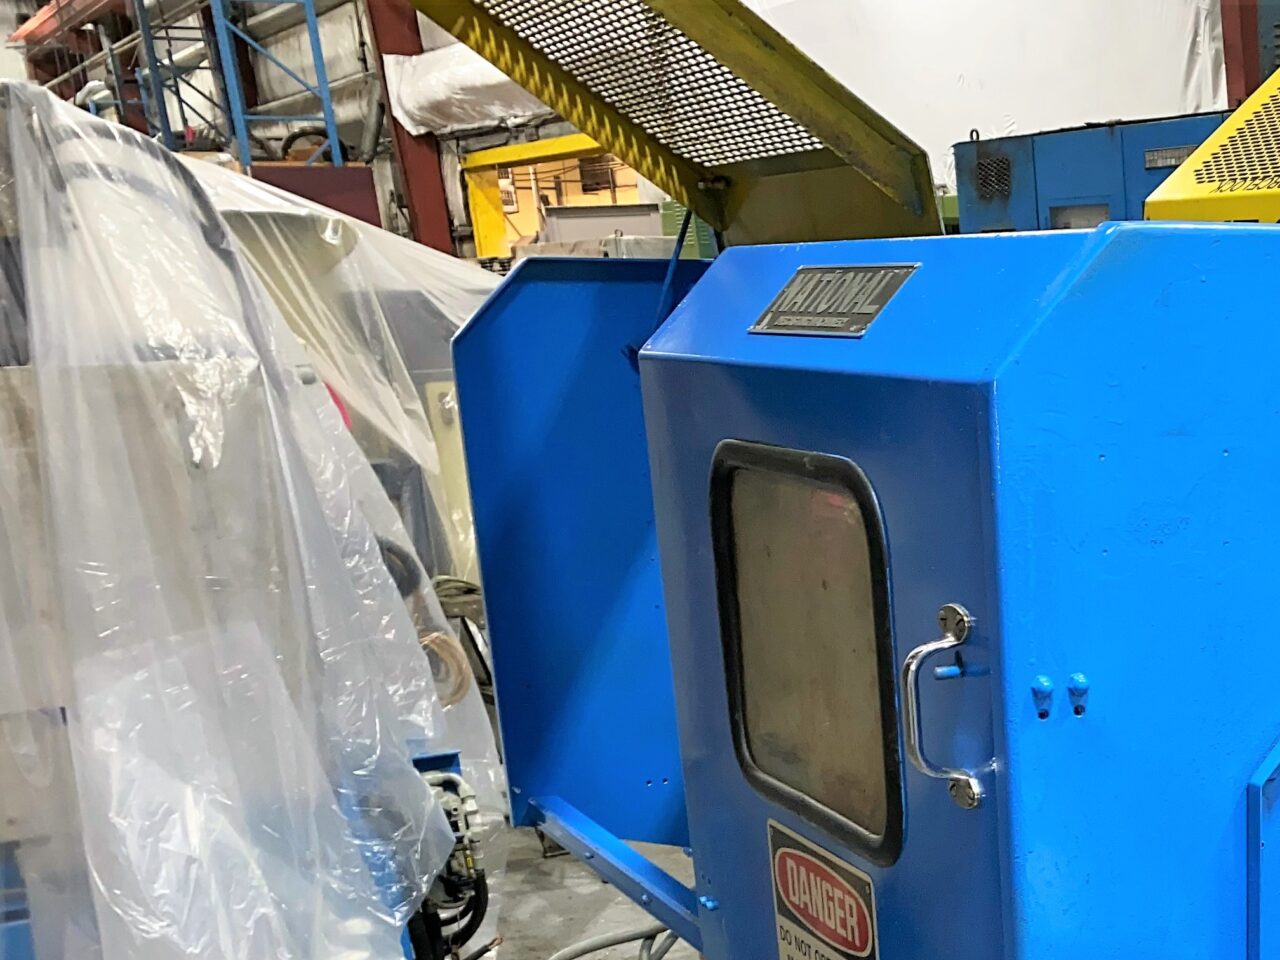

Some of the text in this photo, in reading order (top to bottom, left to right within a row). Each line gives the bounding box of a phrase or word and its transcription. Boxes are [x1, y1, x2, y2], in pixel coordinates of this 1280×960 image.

[770, 271, 895, 315] NATIONAL
[786, 857, 860, 947] DANGER
[780, 925, 792, 946] DO
[795, 936, 811, 960] NOT
